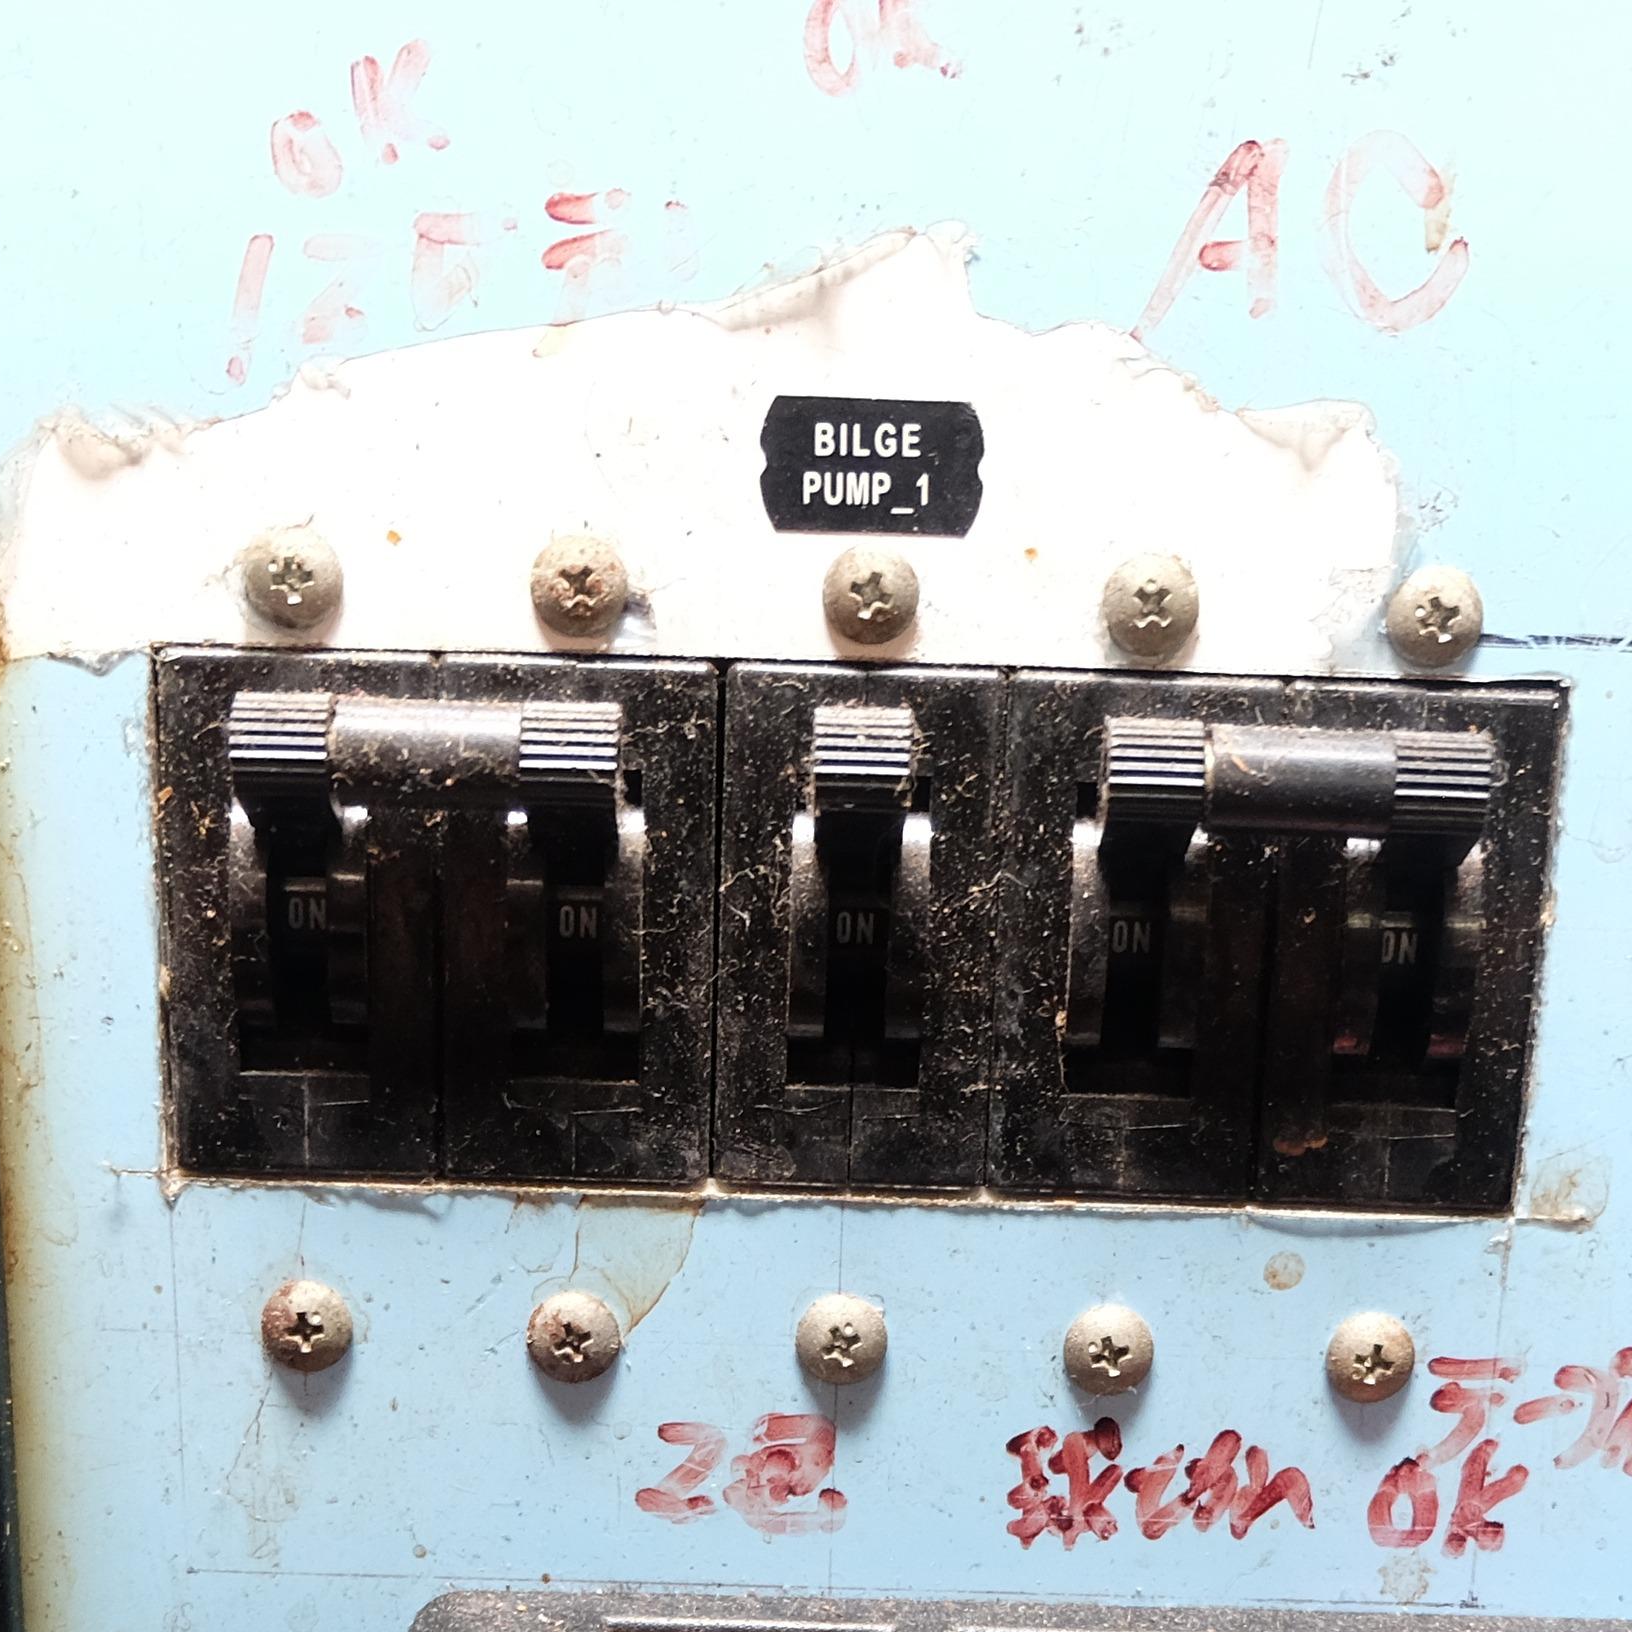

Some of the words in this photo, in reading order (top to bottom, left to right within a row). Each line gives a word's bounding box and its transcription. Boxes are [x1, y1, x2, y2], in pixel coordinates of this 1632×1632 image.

[813, 421, 923, 459] BILGE
[801, 469, 931, 515] PUMP_1
[287, 896, 327, 931] ON
[559, 904, 598, 939] ON
[836, 911, 876, 946] ON
[1112, 919, 1151, 955] ON
[1381, 930, 1418, 965] ON
[1366, 1438, 1529, 1558] OK
